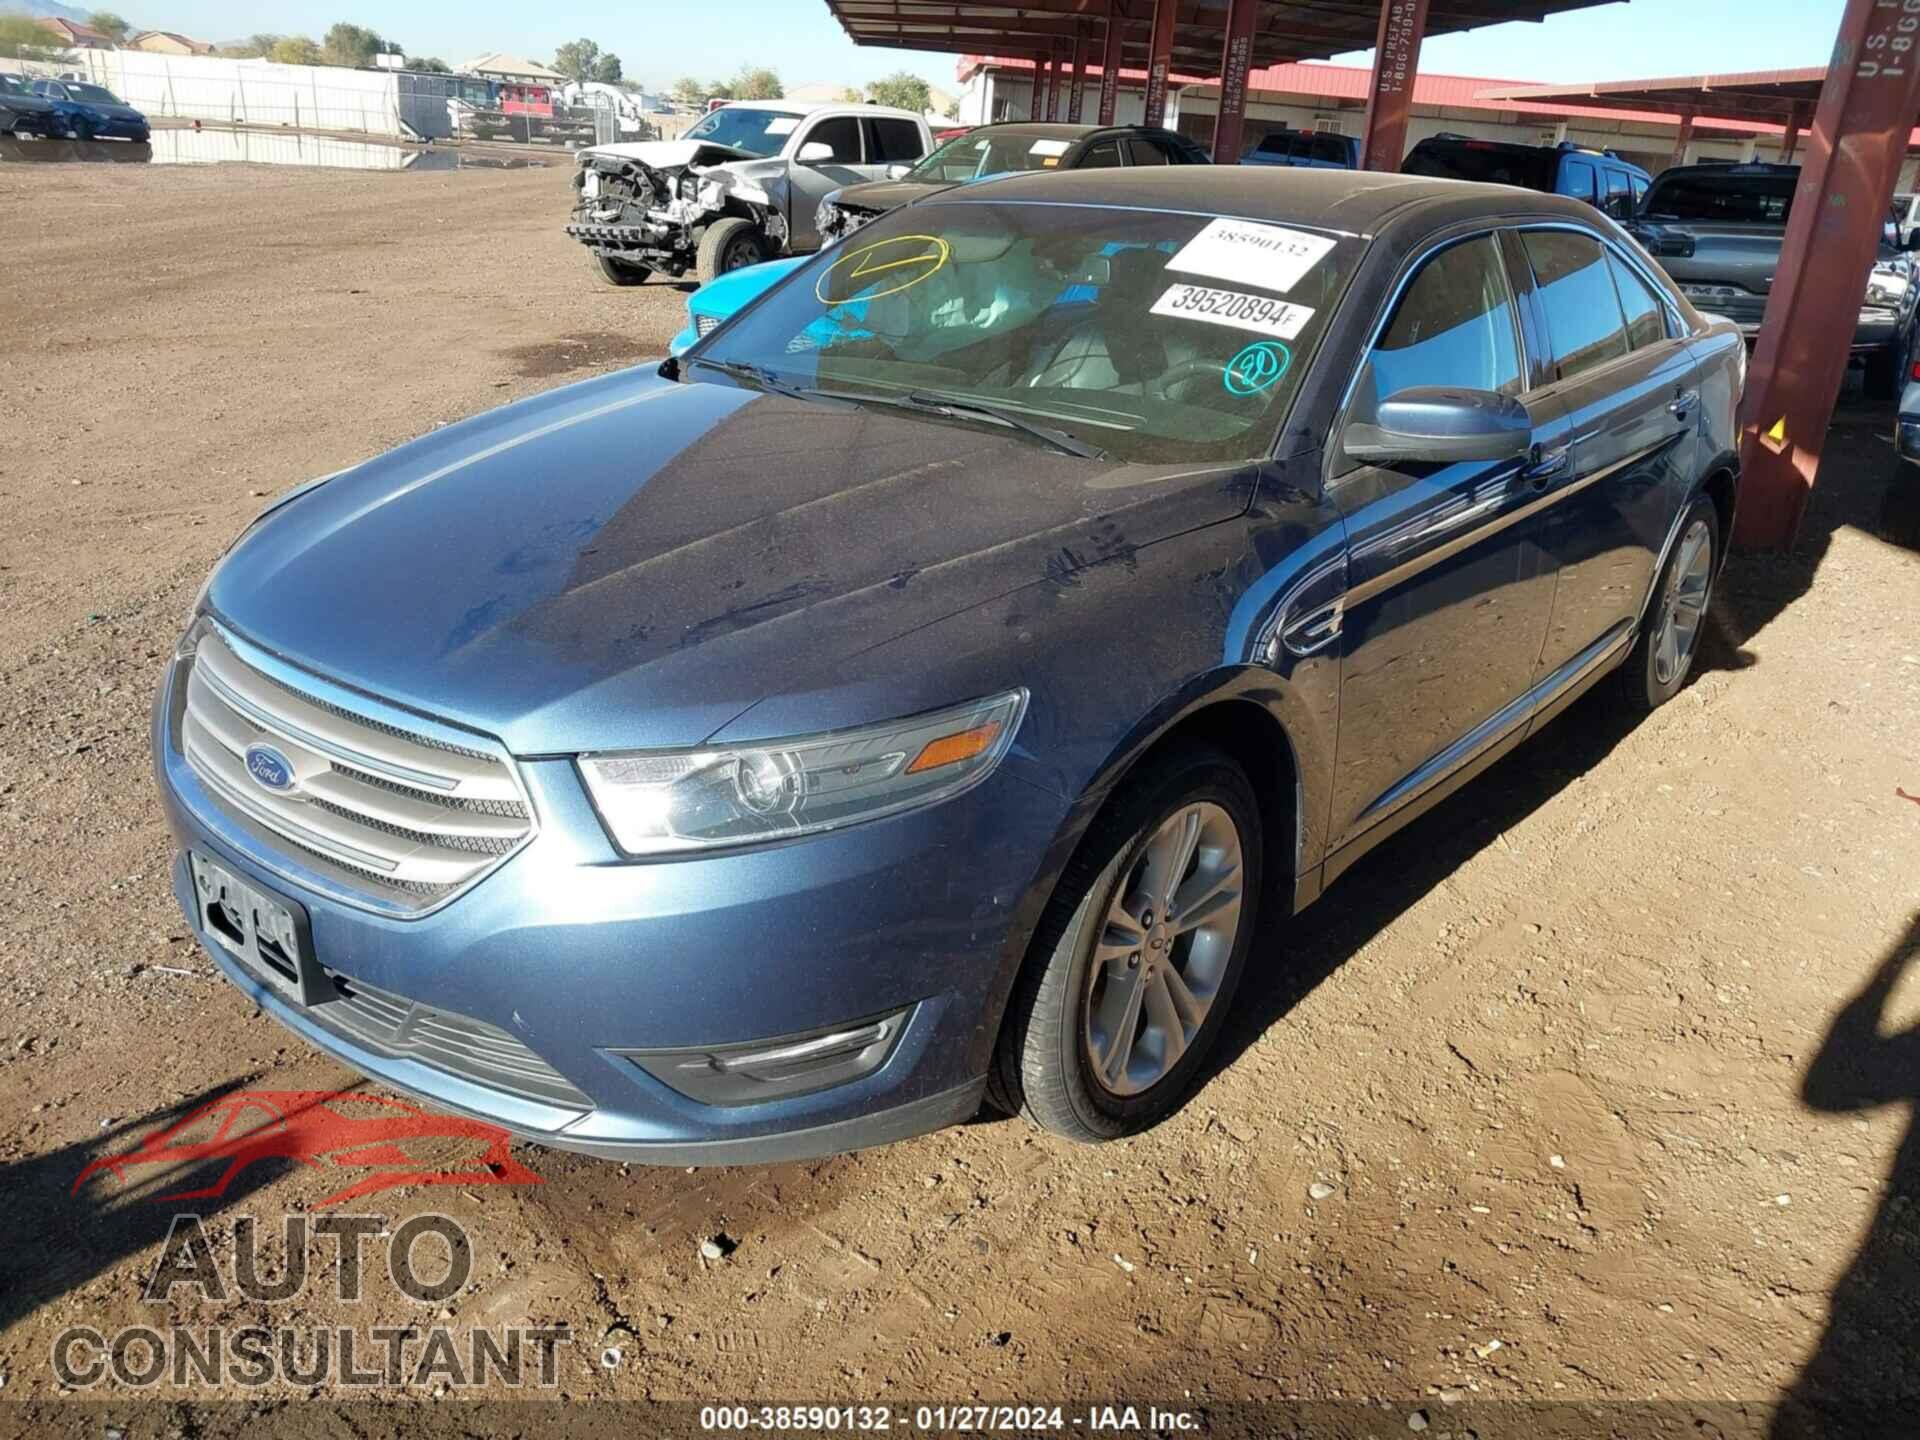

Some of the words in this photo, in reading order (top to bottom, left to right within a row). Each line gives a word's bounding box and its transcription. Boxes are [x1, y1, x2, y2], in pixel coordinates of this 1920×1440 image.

[1384, 5, 1403, 59] PREFAB
[1213, 229, 1309, 257] 38590132
[251, 753, 281, 784] Ford
